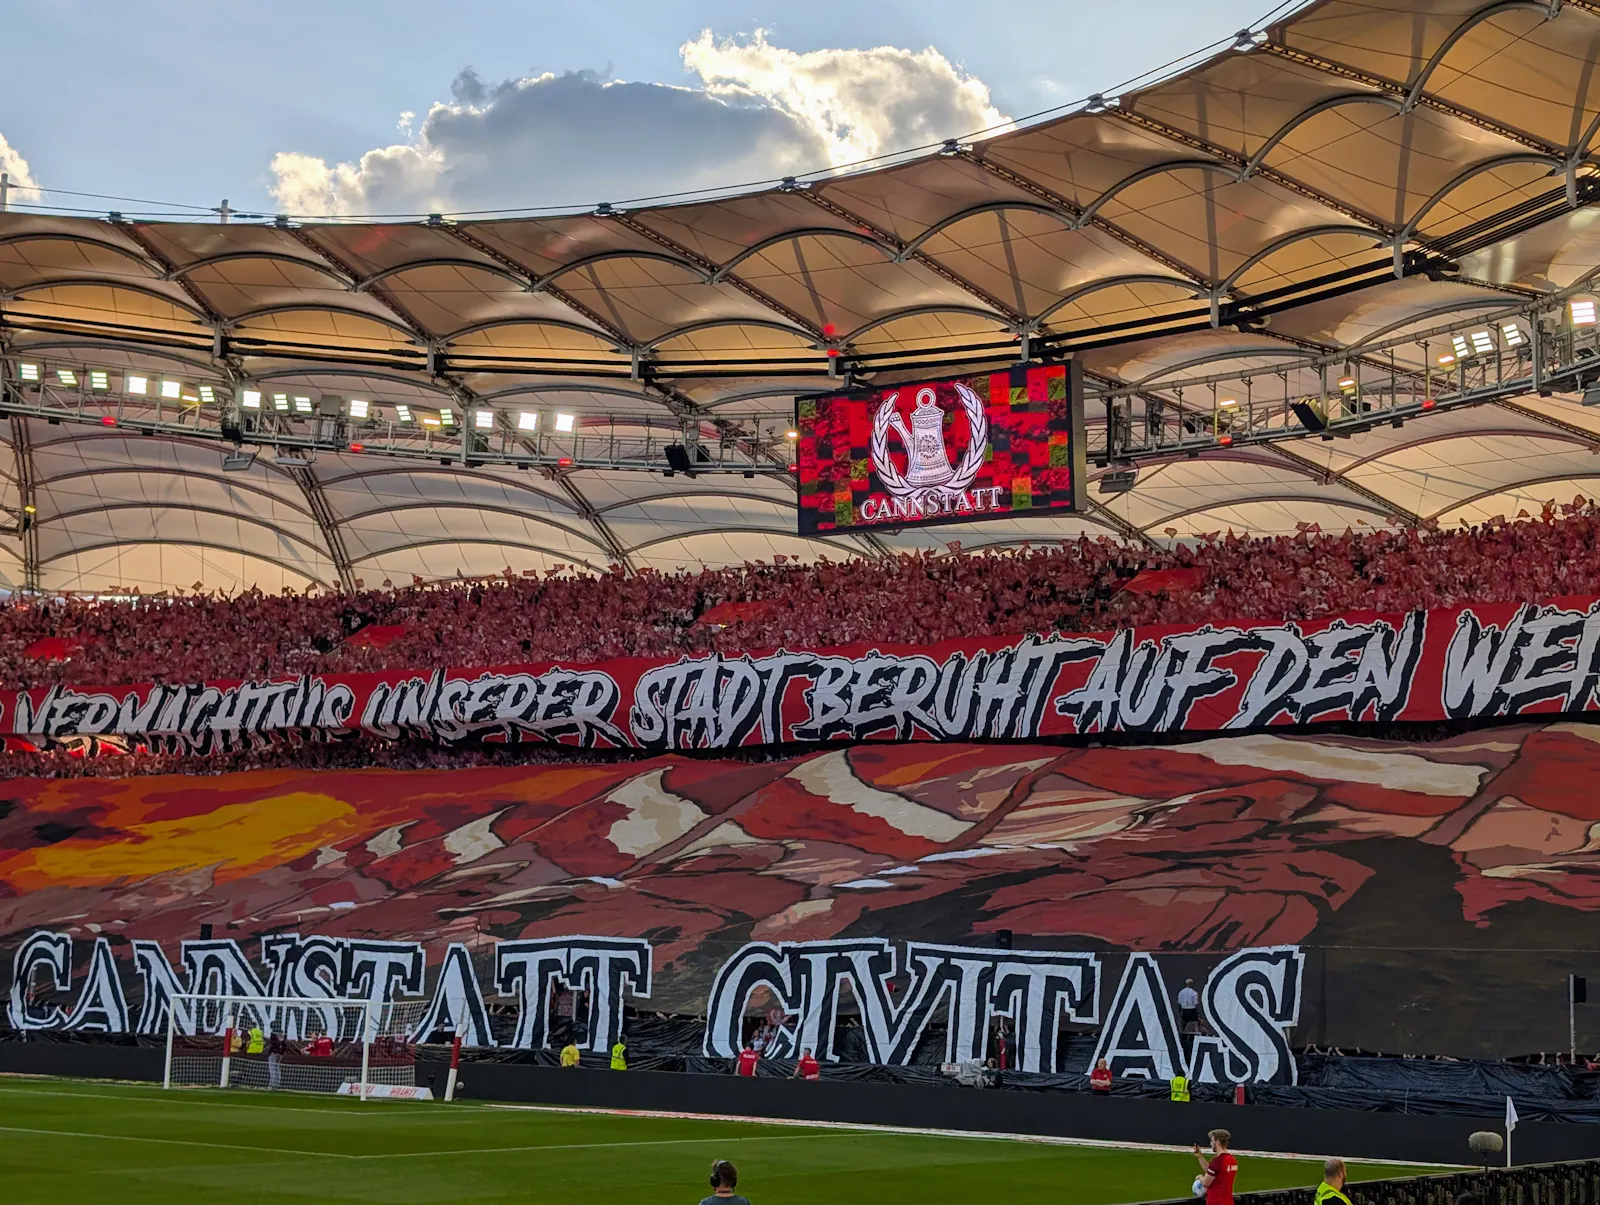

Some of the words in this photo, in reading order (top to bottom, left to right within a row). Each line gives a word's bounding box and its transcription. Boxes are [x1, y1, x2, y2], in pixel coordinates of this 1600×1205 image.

[860, 486, 1004, 520] CANNSTATT
[361, 667, 634, 748] UNSERER
[630, 647, 824, 749] STADT
[788, 632, 1104, 741] BERUHT
[1055, 624, 1252, 735] AUF
[1219, 609, 1428, 730] DEN
[7, 930, 653, 1053] CANNSTATT
[703, 936, 1305, 1087] CIVITAS
